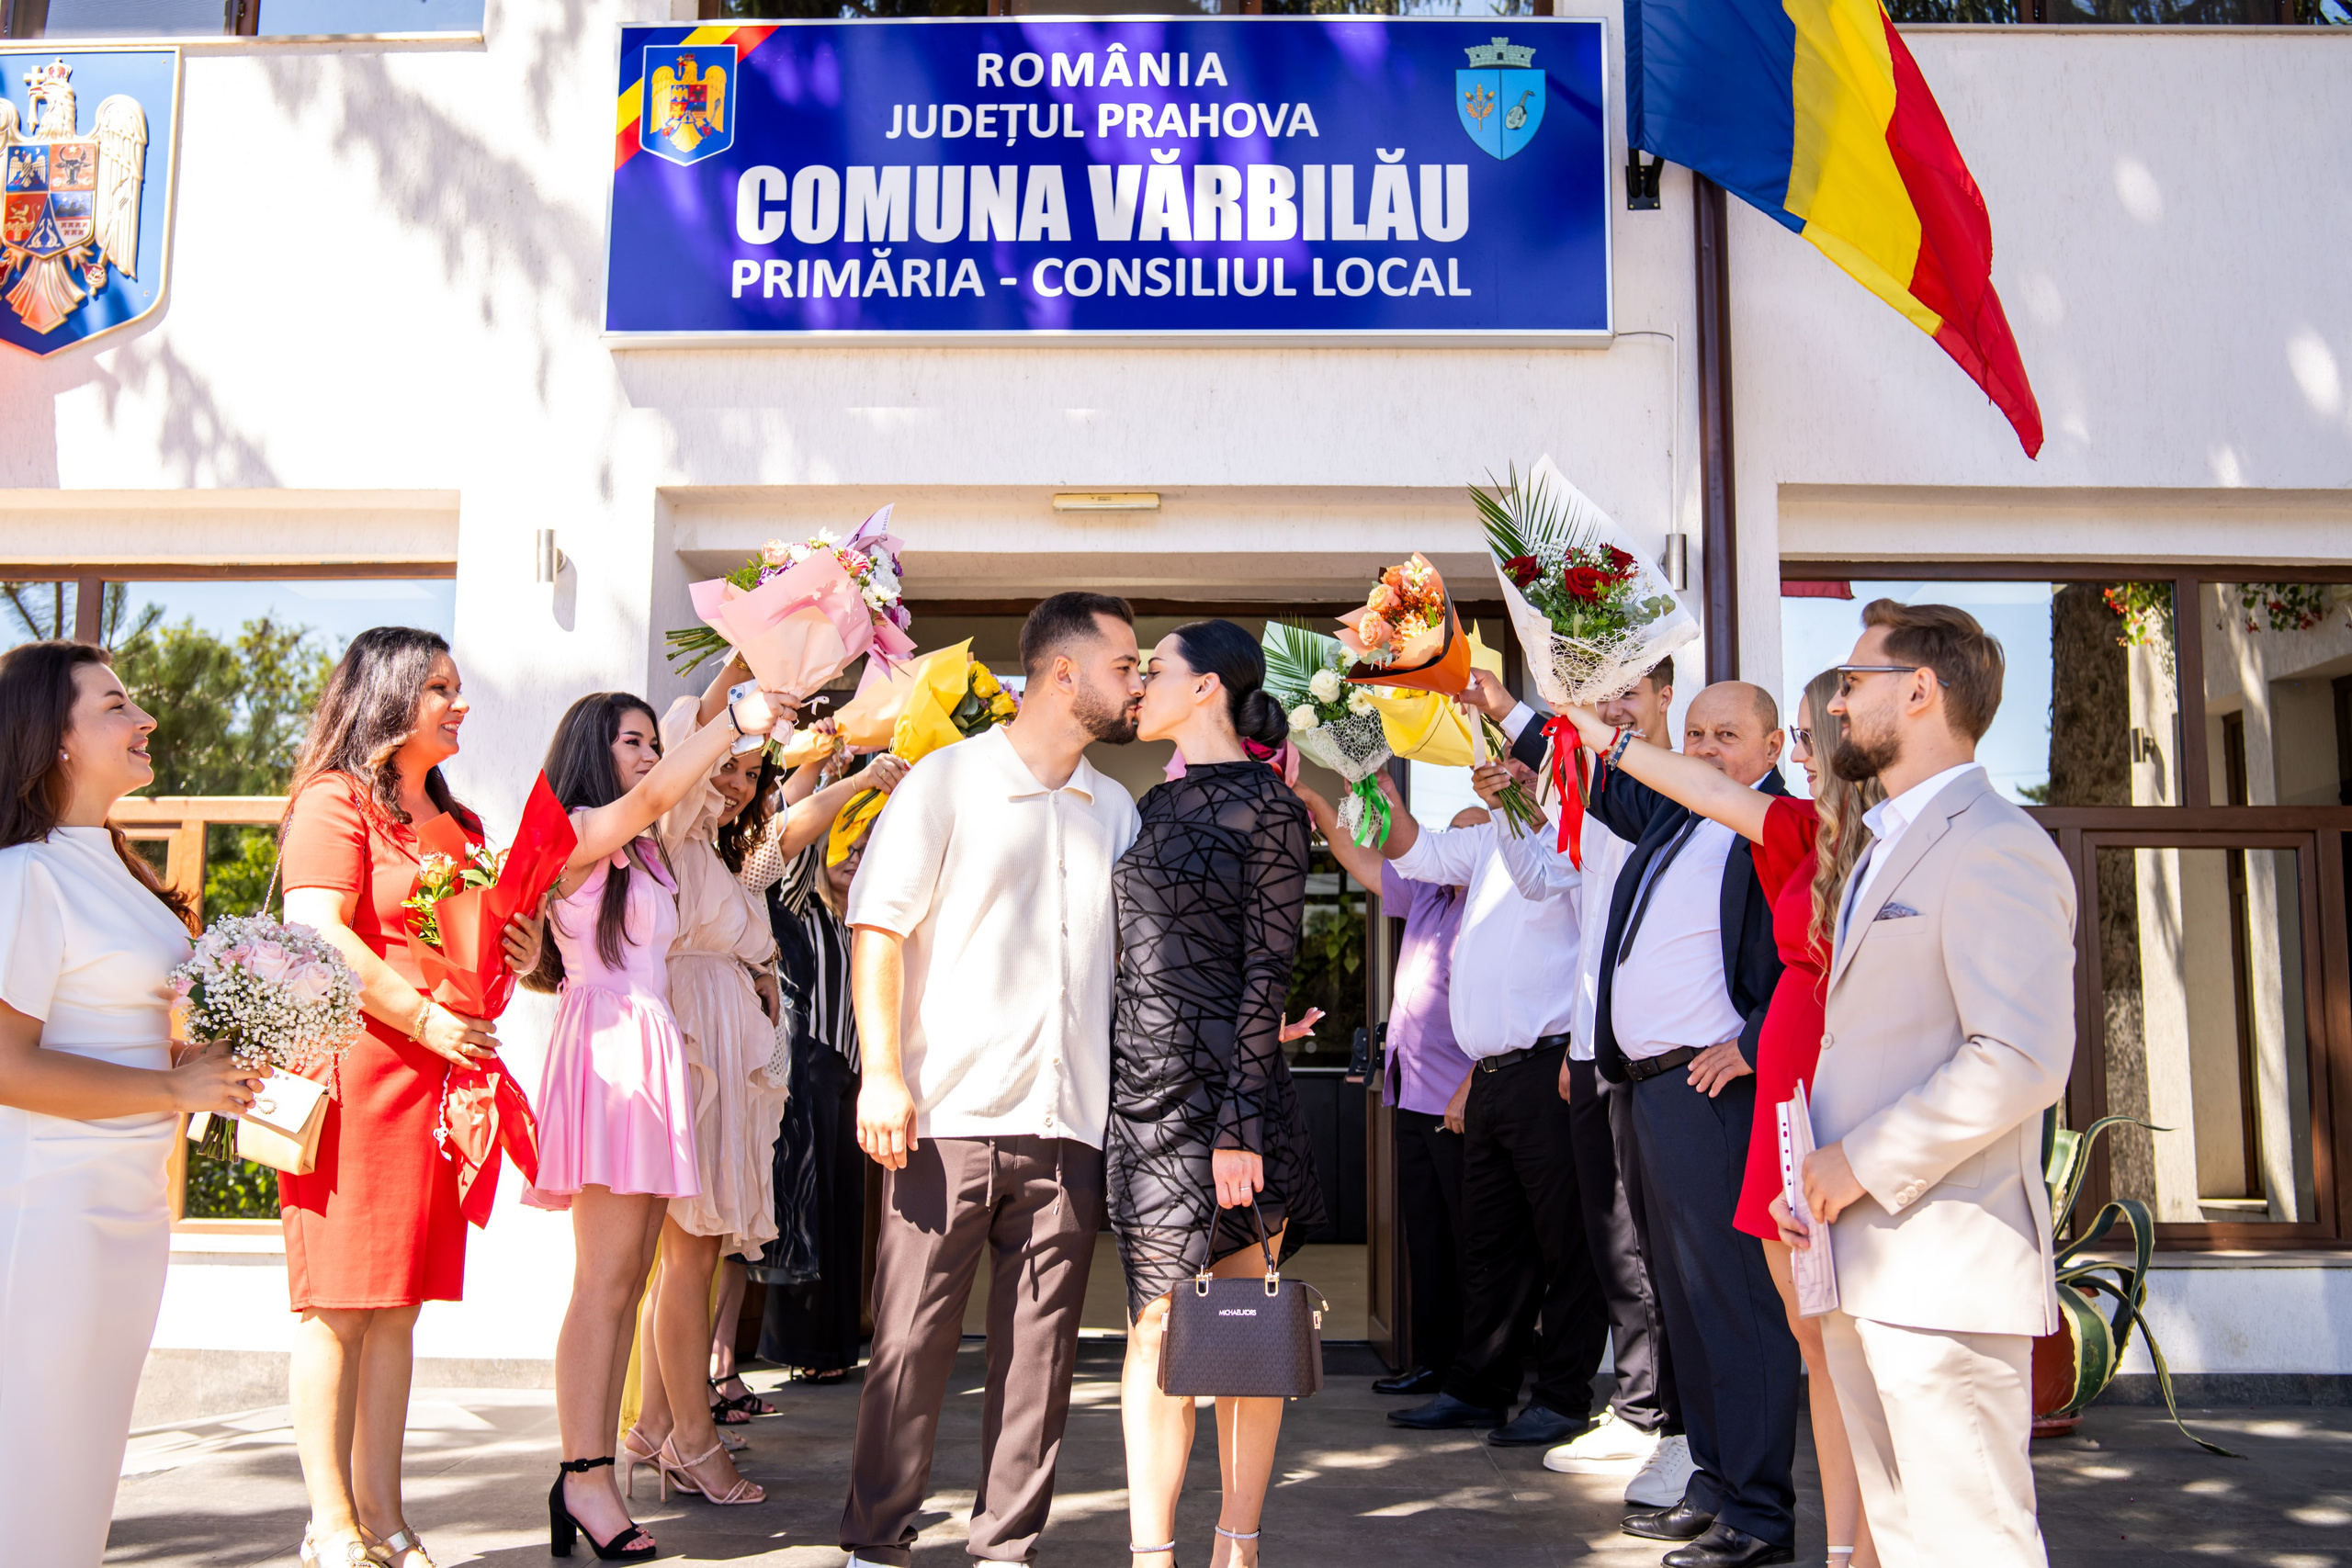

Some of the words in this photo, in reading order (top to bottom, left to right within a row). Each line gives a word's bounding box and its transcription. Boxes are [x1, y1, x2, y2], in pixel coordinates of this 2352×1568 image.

[978, 42, 1228, 87] ROMÂNIA
[885, 103, 1084, 148] JUDEȚUL
[1098, 102, 1319, 139] PRAHOVA
[736, 164, 1071, 245] COMUNA
[1087, 148, 1469, 243] VĂRBILĂU
[731, 247, 986, 299] PRIMĂRIA
[1000, 277, 1017, 286] -
[1032, 257, 1297, 298] CONSILIUL
[1313, 257, 1472, 297] LOCAL
